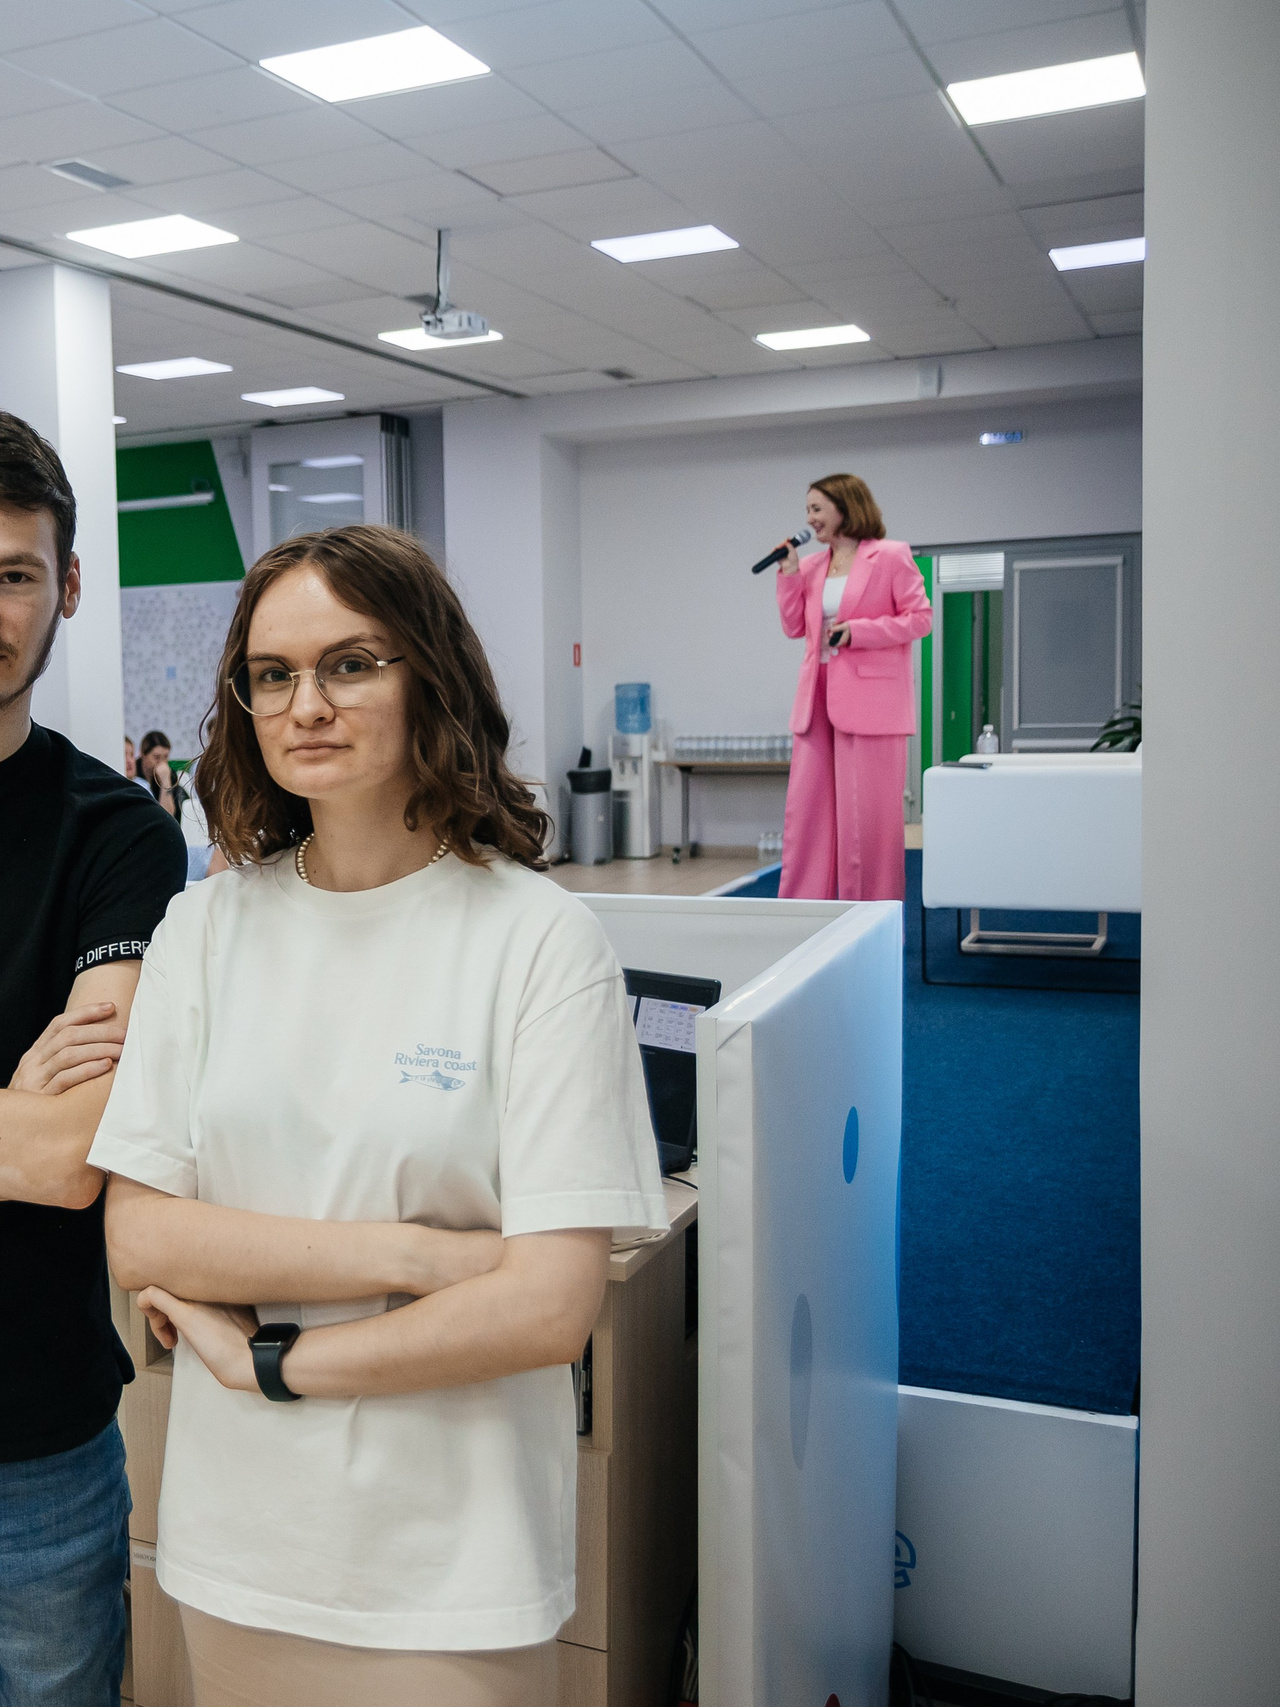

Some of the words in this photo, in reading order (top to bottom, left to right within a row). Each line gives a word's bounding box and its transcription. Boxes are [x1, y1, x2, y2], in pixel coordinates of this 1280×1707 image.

[415, 1043, 462, 1060] Savona
[394, 1052, 440, 1068] Riviera
[444, 1060, 478, 1072] coast
